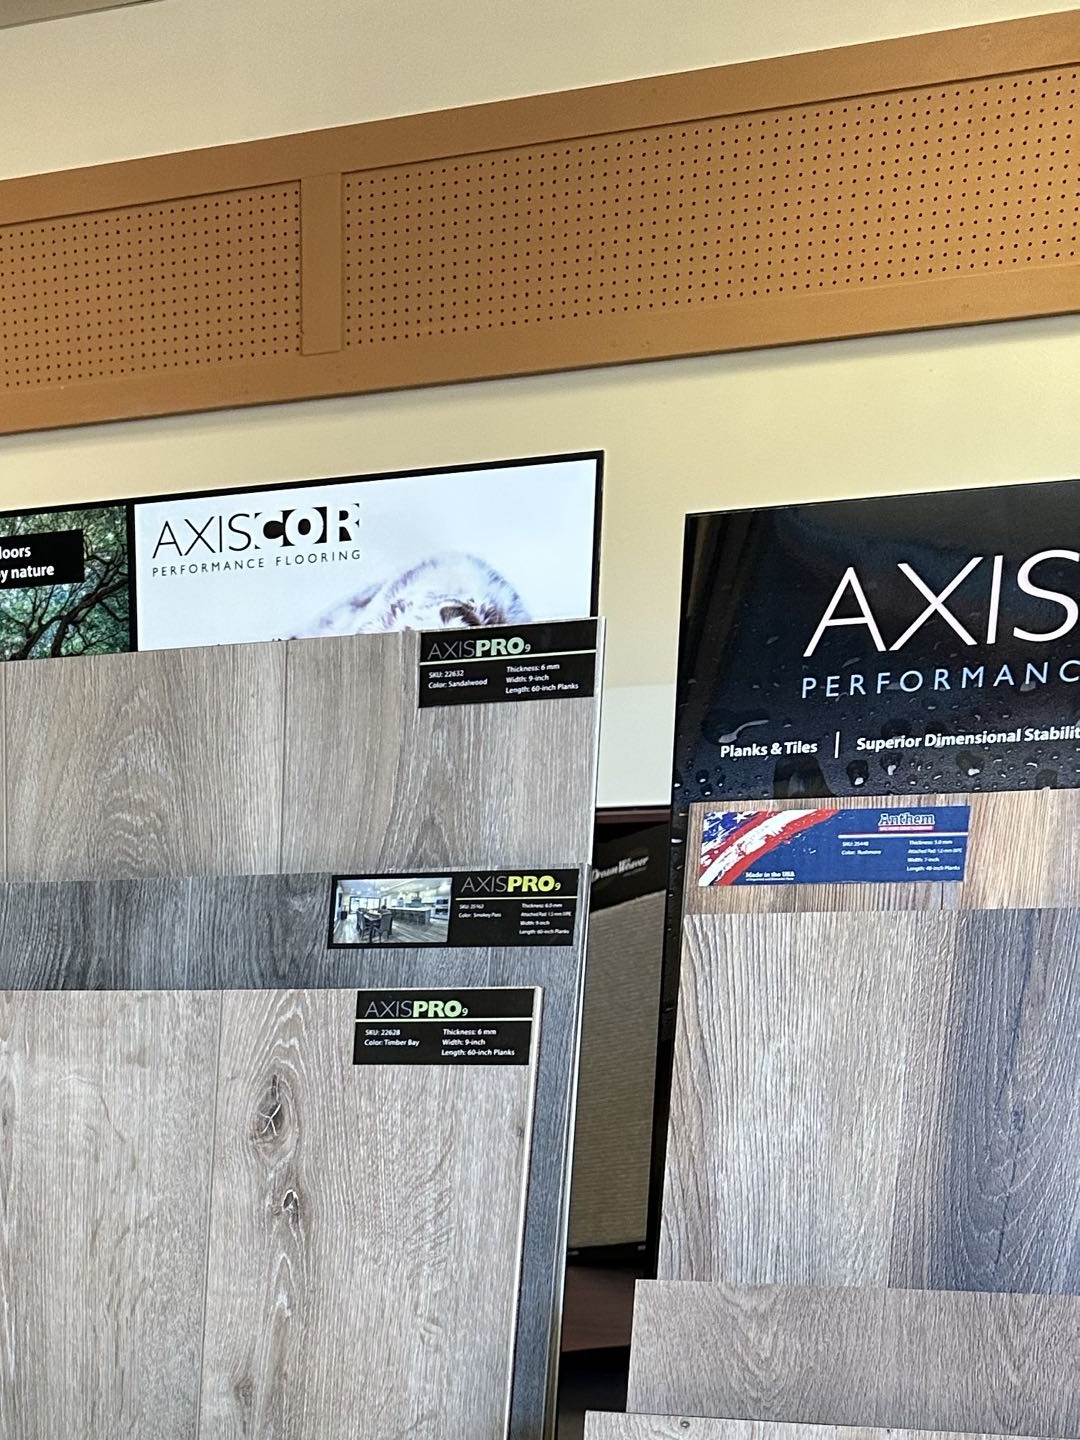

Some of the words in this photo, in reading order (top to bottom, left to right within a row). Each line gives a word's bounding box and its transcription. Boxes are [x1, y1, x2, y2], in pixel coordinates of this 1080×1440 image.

[20, 563, 55, 578] nature
[152, 559, 265, 577] PERFORMANCE
[275, 550, 361, 567] FLOORING
[803, 549, 1080, 657] AXIS
[448, 679, 488, 687] Sandalwood
[857, 736, 920, 752] Superior
[925, 729, 1021, 747] Dimensional
[720, 745, 768, 758] Planks
[770, 742, 781, 755] &
[785, 740, 818, 754] Tiles
[878, 812, 935, 826] Anthem
[408, 1039, 420, 1047] Bay
